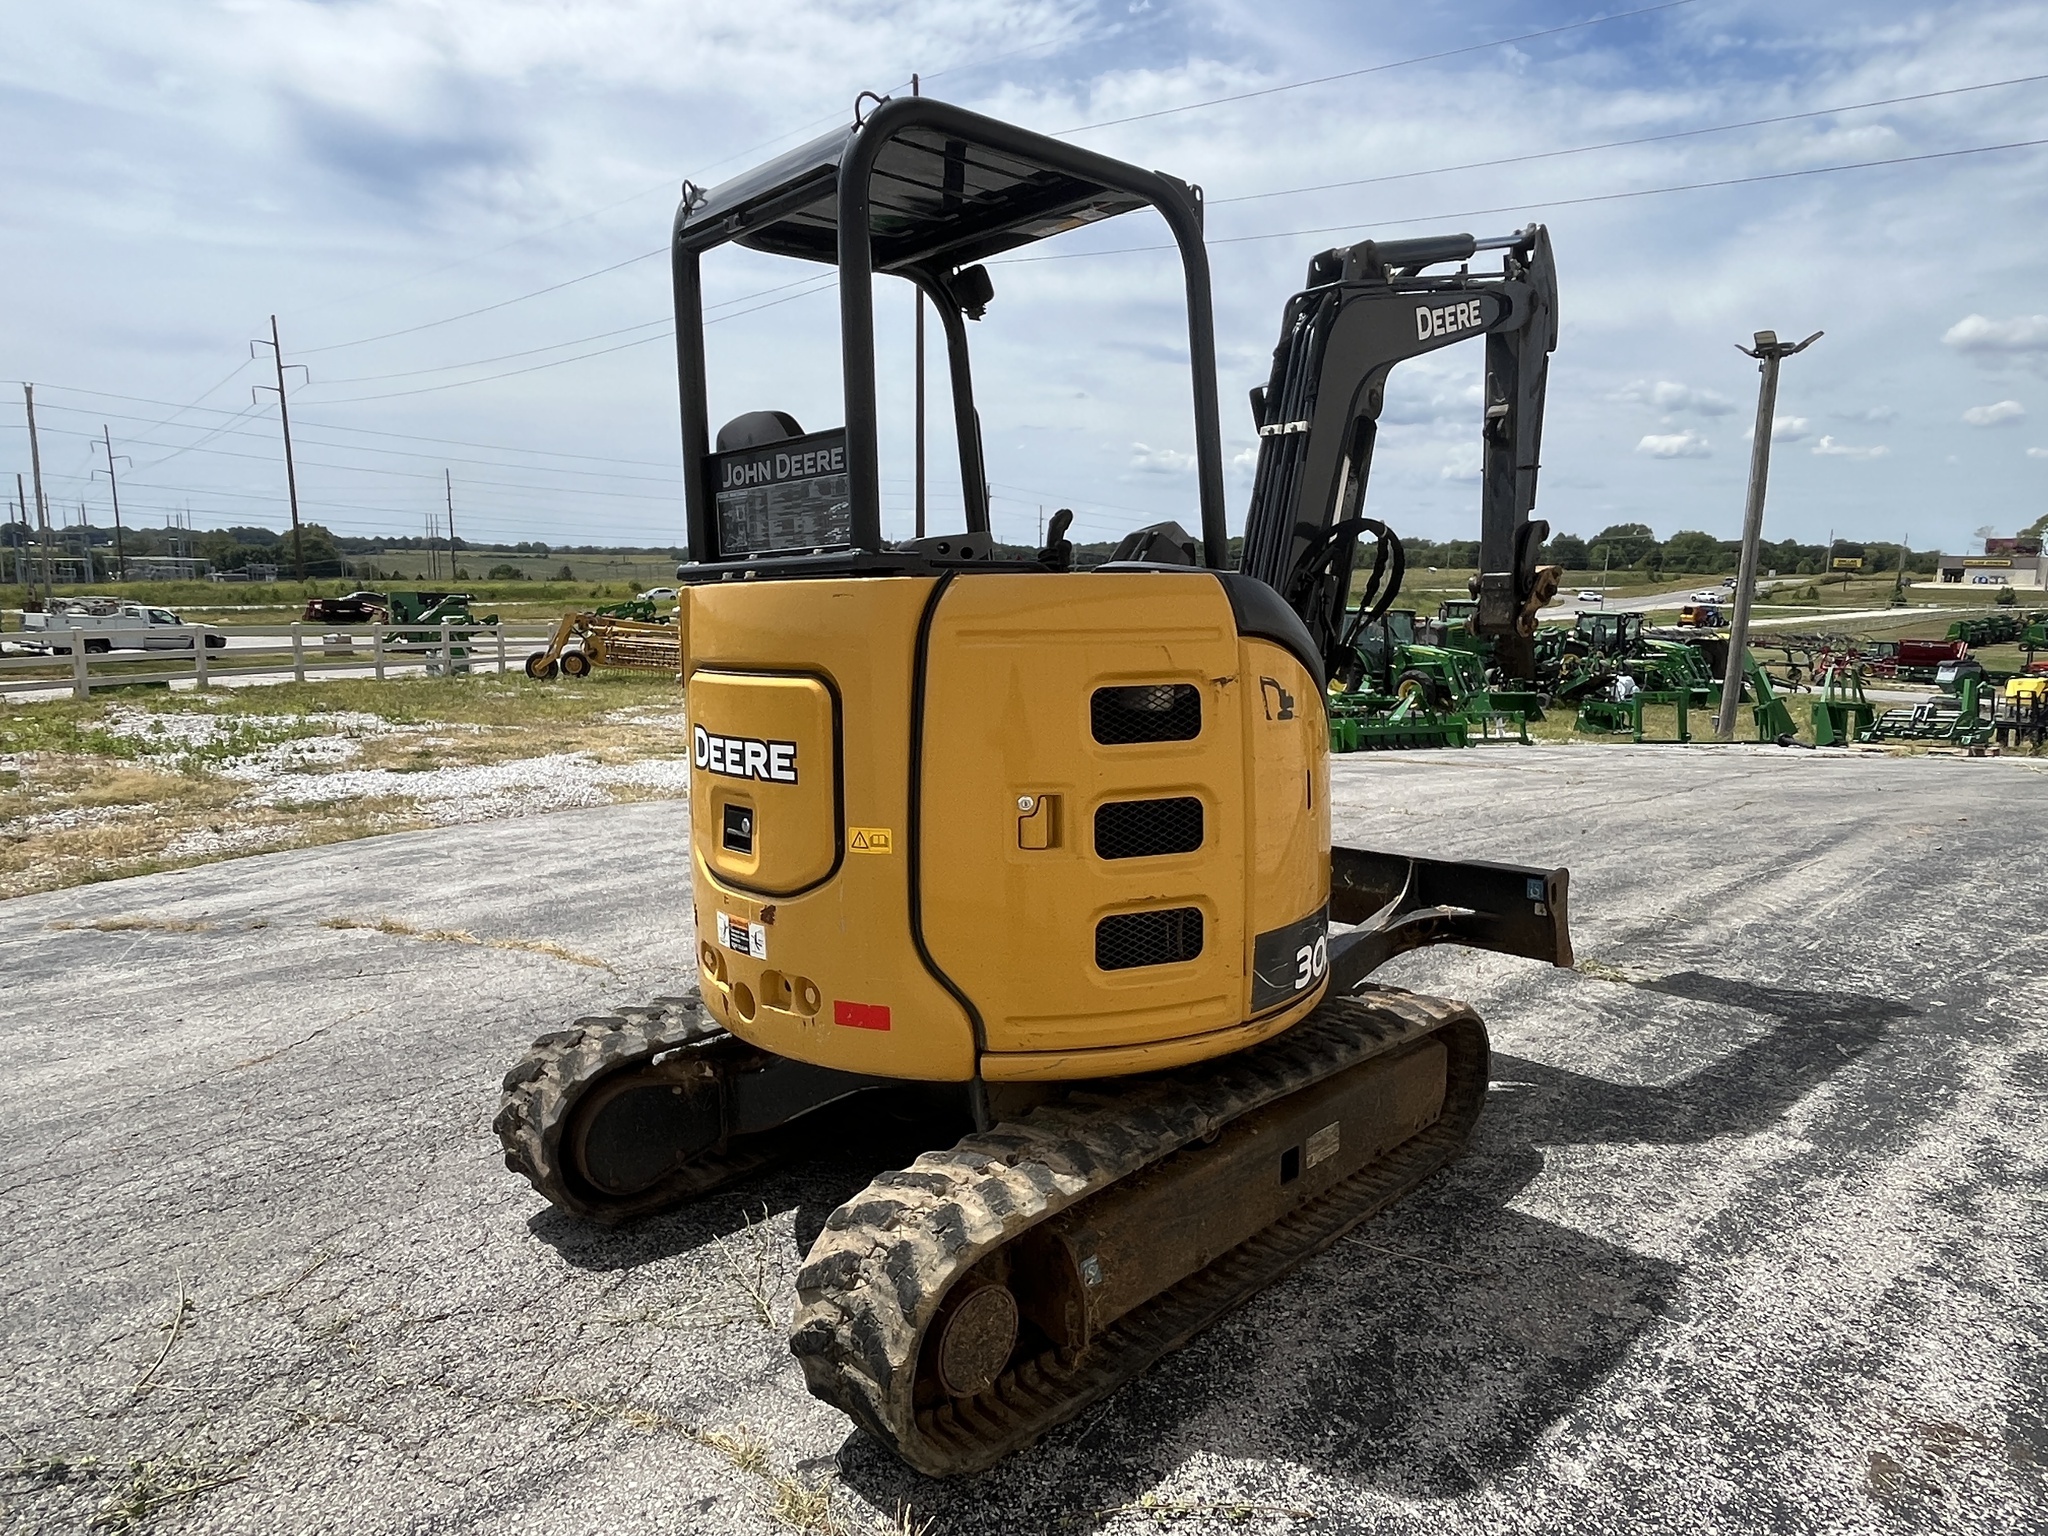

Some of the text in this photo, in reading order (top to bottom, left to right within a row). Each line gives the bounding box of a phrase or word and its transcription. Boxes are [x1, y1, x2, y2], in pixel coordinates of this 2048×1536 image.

[1416, 299, 1482, 341] DEERE
[722, 446, 845, 488] JOHN DEERE
[694, 726, 796, 781] DEERE
